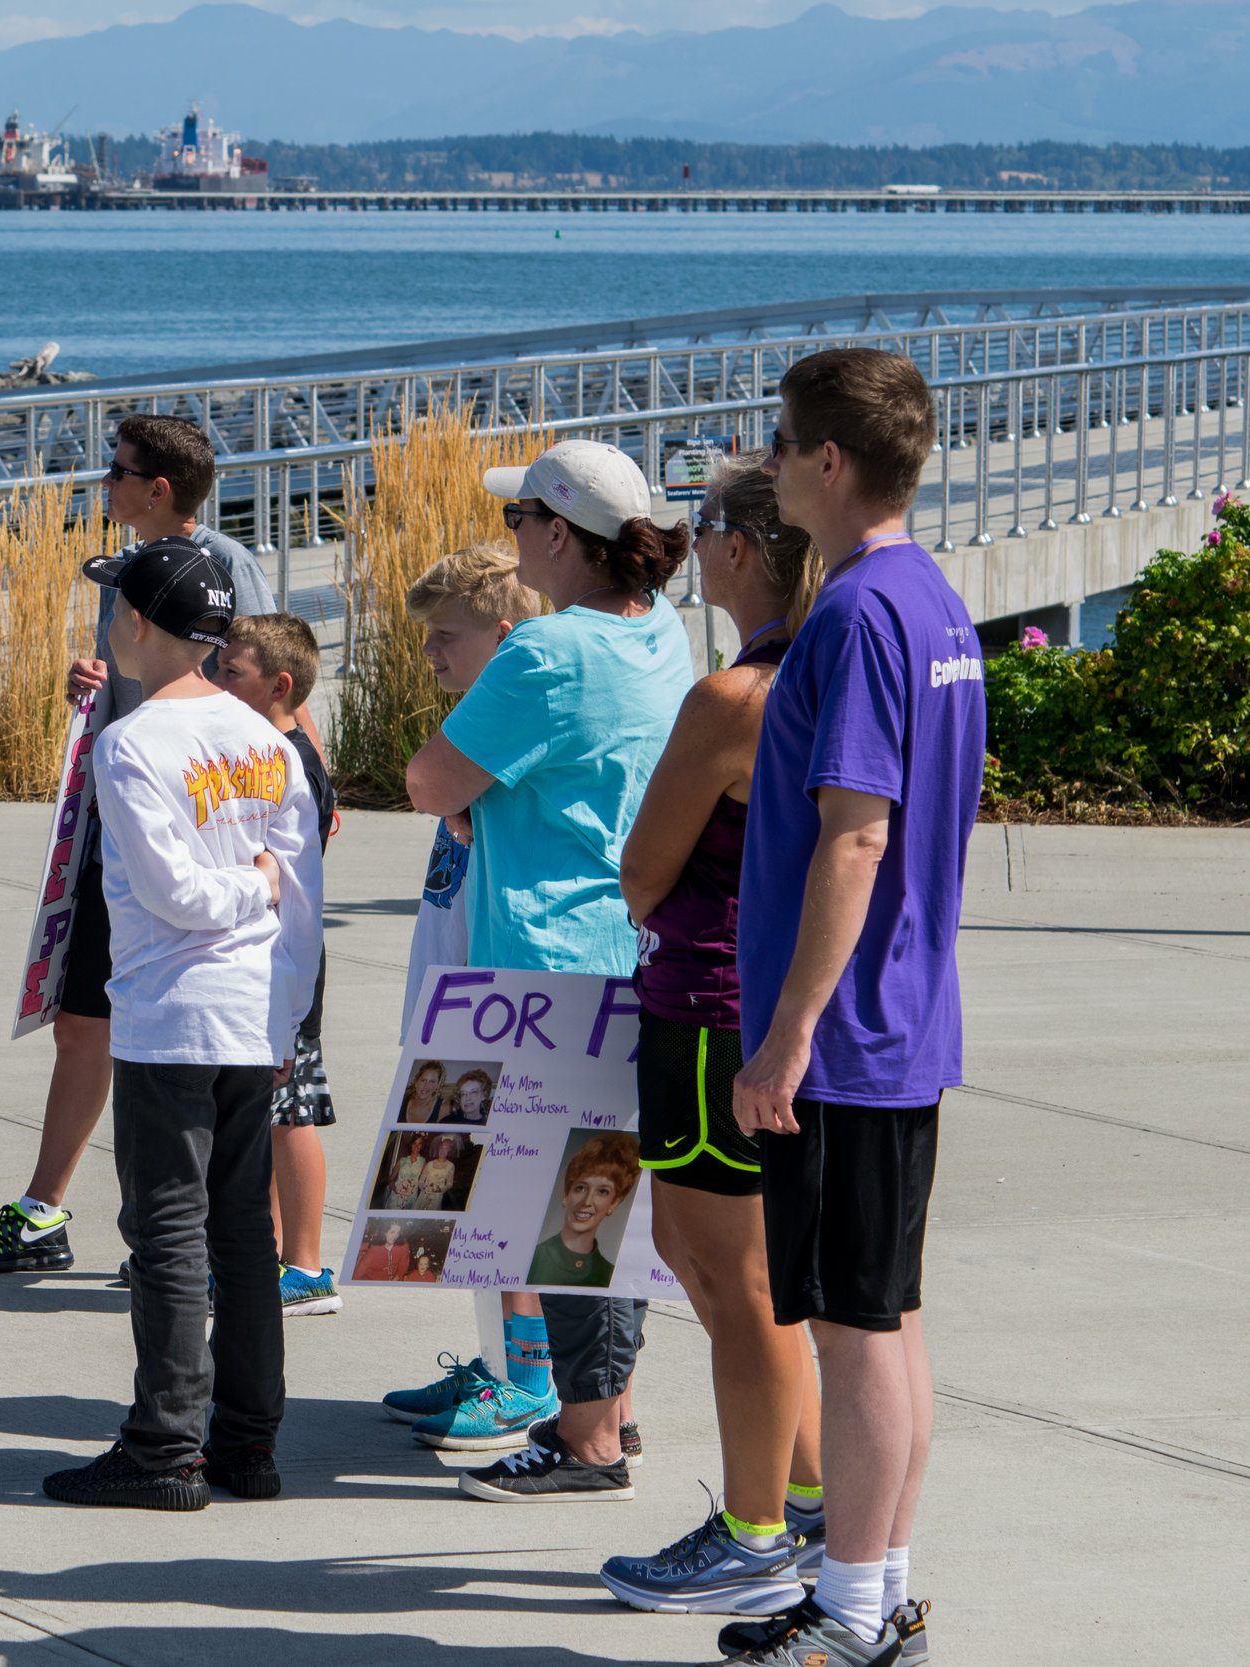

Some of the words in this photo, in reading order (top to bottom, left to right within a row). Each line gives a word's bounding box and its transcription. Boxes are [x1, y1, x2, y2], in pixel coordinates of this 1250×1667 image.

[207, 588, 232, 609] NM
[189, 632, 206, 641] NEW
[205, 636, 229, 649] MEXICO
[421, 971, 557, 1051] FOR
[499, 1074, 516, 1096] My
[518, 1075, 544, 1092] Mom
[494, 1131, 511, 1148] My
[515, 1144, 539, 1157] Mom
[452, 1227, 468, 1247] My
[448, 1248, 461, 1264] My
